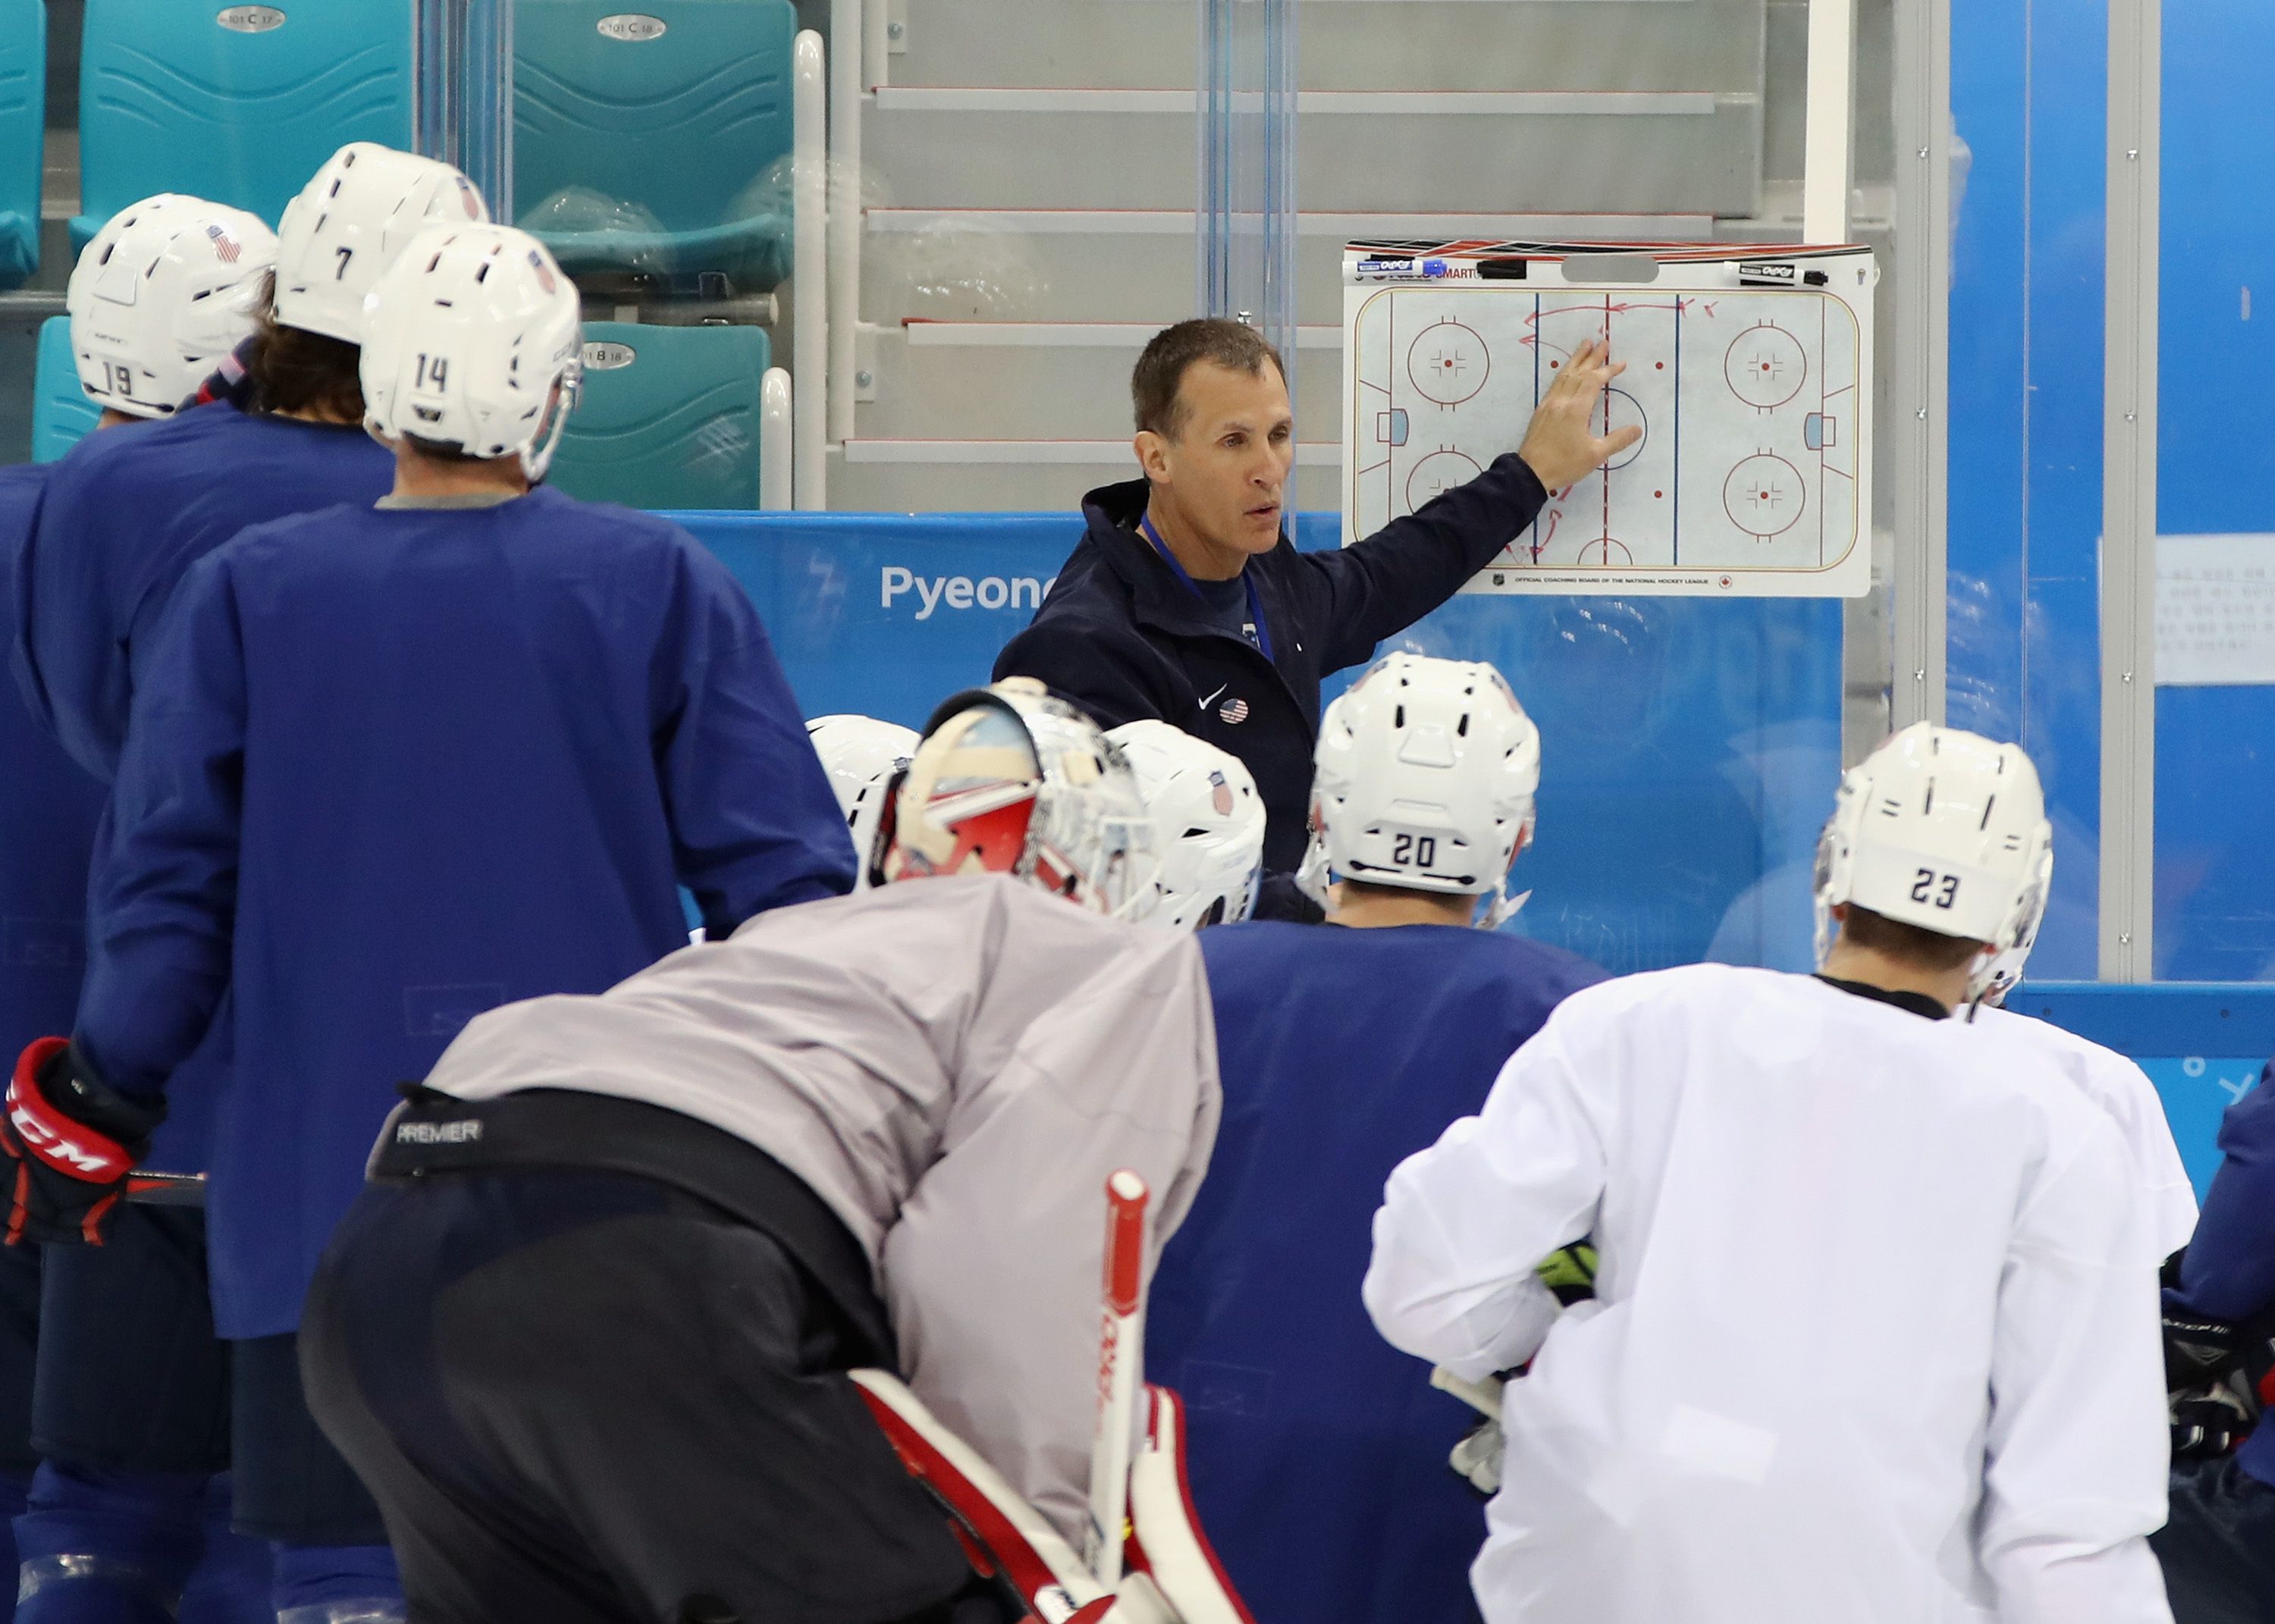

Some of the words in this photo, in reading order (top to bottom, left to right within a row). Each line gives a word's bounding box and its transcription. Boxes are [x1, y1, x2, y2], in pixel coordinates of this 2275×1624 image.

[247, 14, 257, 24] C
[629, 23, 638, 33] C
[335, 246, 353, 281] 7
[597, 350, 606, 361] B
[103, 362, 131, 395] 19
[416, 353, 447, 393] 14
[1393, 833, 1436, 868] 20
[1911, 867, 1960, 908] 23
[396, 1120, 483, 1143] PREMIER
